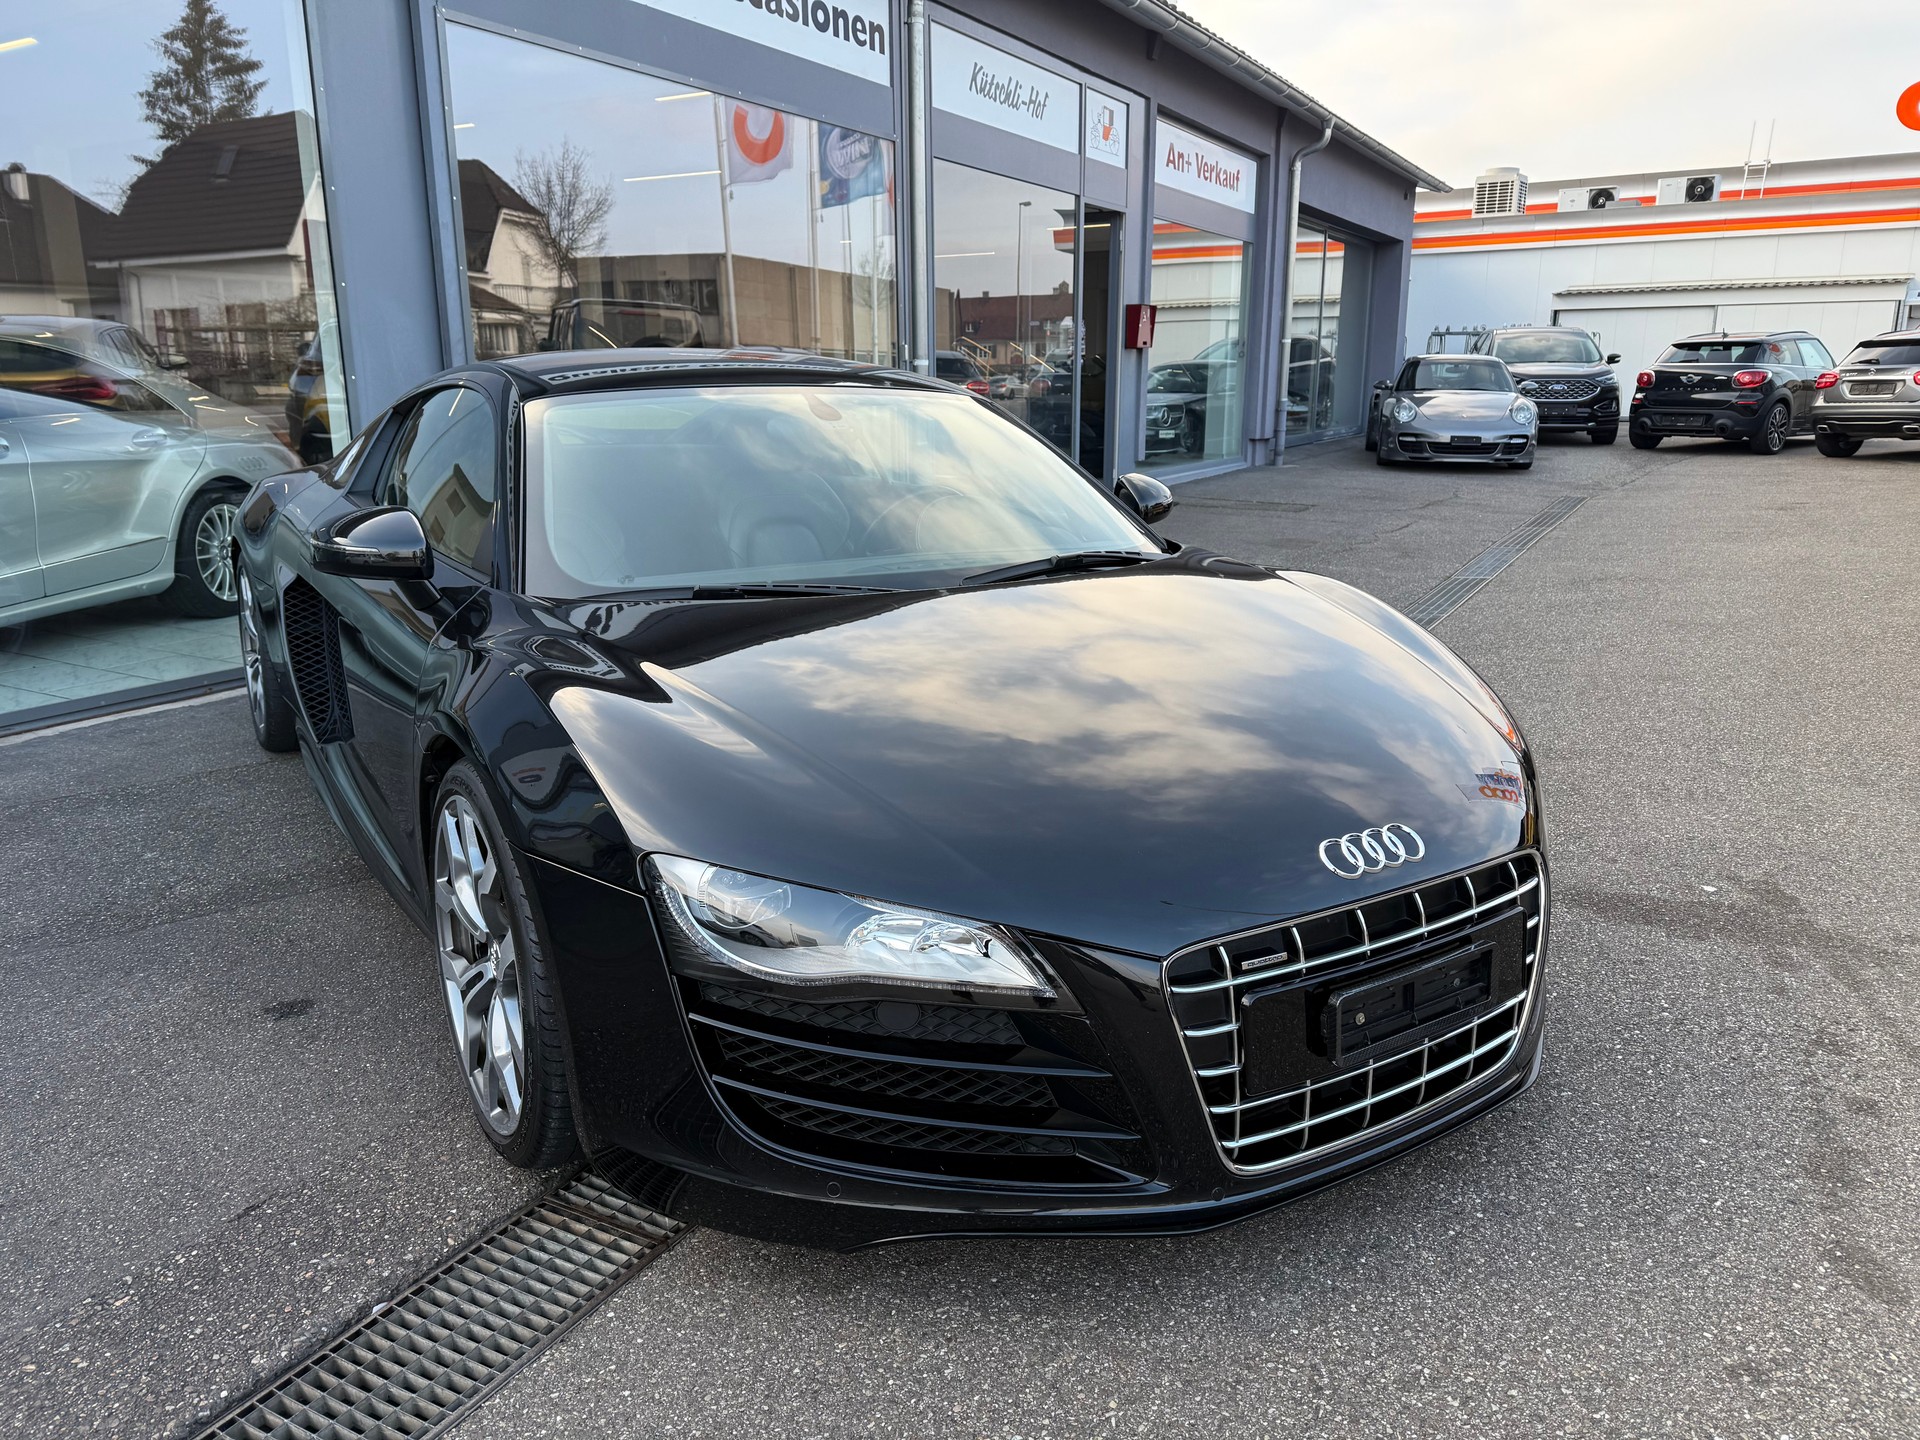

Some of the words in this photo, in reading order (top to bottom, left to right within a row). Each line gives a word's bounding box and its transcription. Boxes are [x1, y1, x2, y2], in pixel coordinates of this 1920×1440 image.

[735, 0, 886, 56] asionen
[969, 61, 1049, 120] Kütschli-Hof
[1195, 152, 1240, 192] Verkauf
